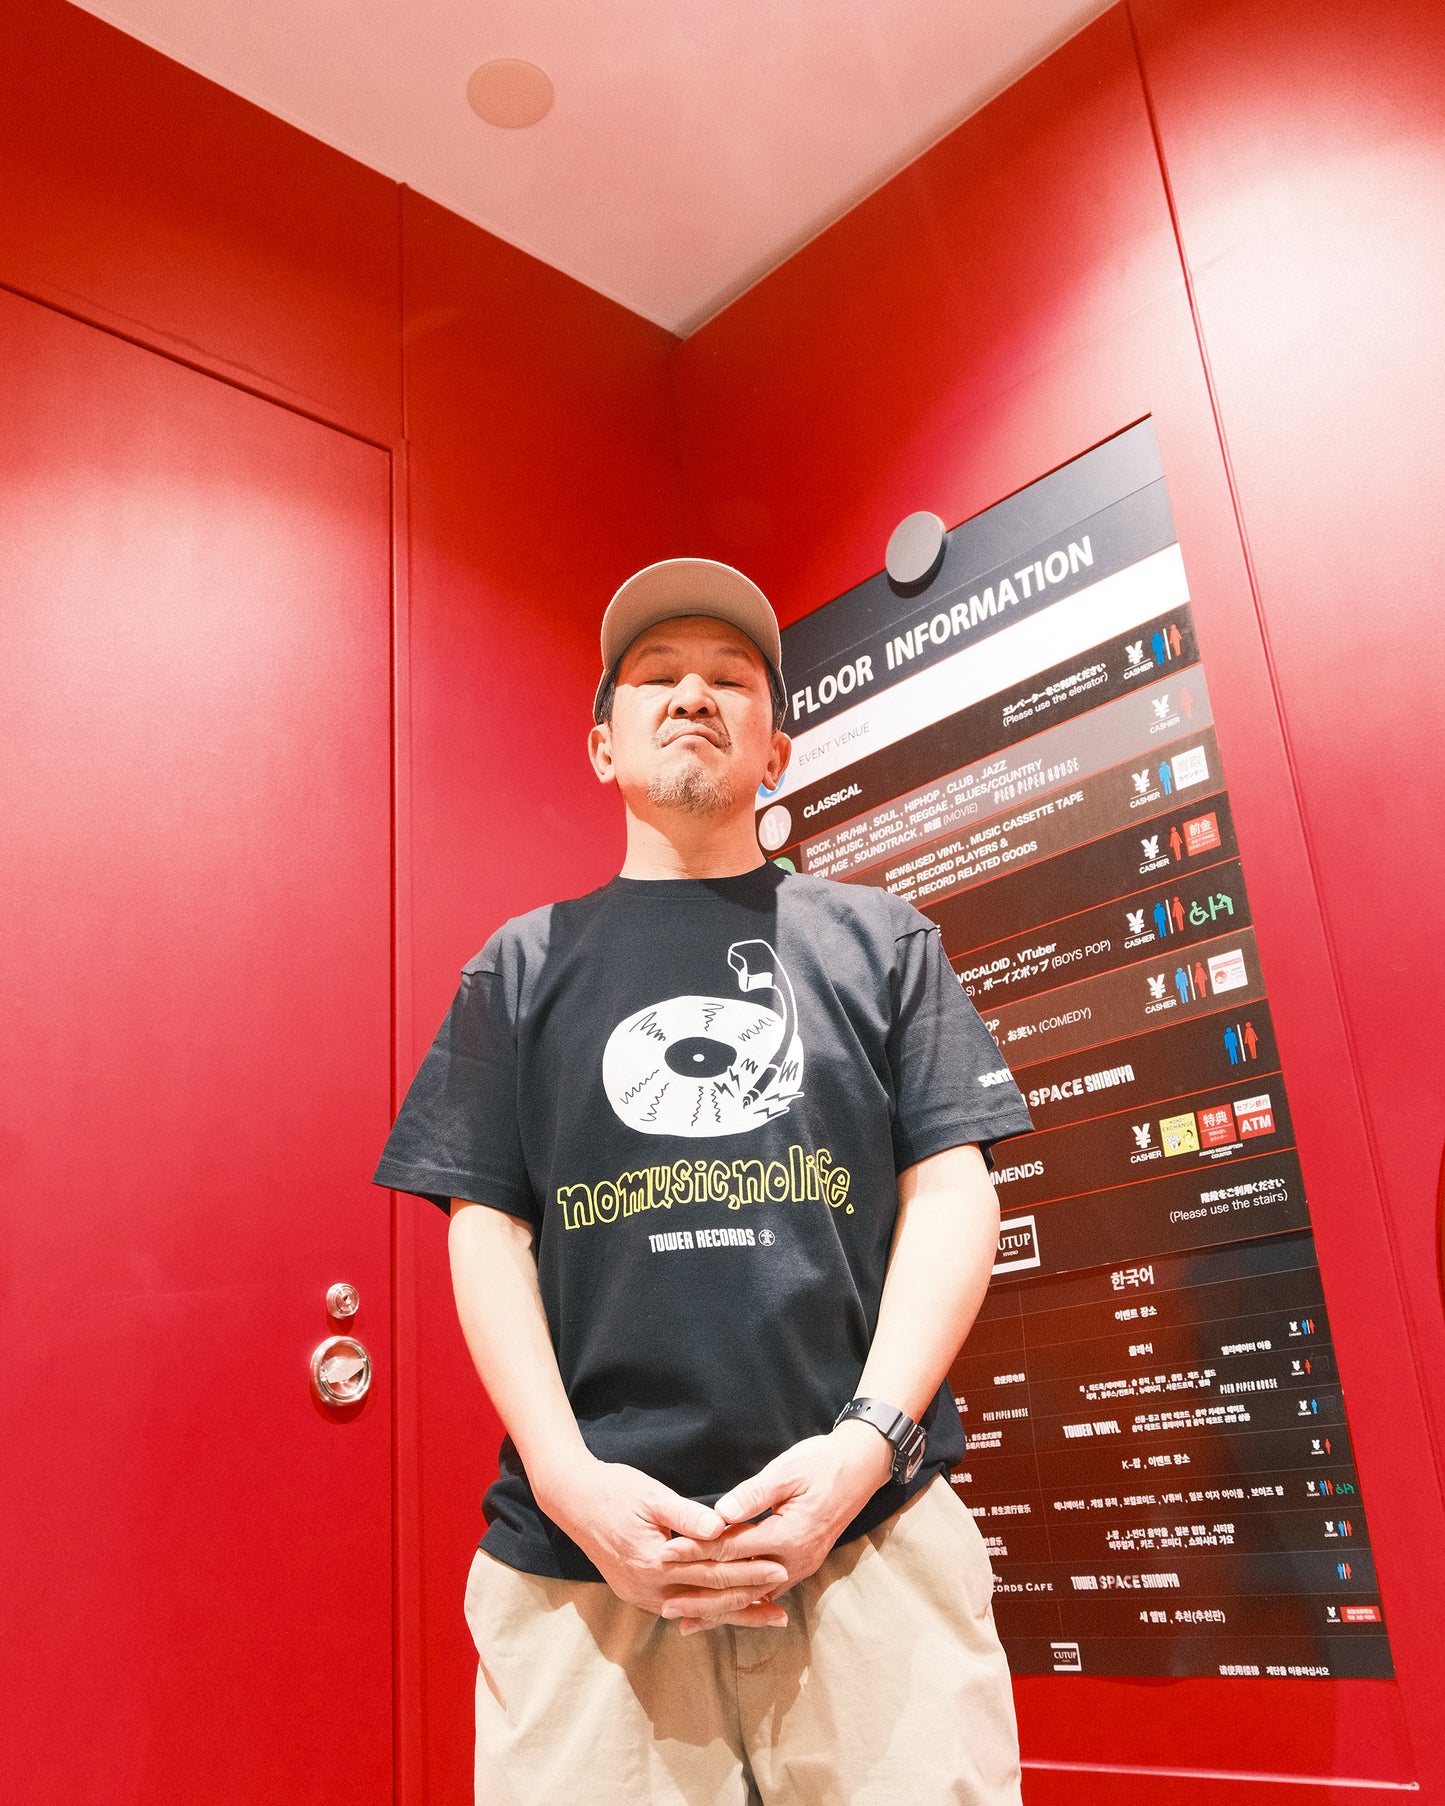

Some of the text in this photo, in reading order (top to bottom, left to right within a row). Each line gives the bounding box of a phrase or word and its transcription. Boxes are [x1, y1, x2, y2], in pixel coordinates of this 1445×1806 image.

[792, 535, 1094, 721] FLOOR INFORMATION
[1123, 662, 1154, 680] CASHIER
[1002, 671, 1109, 728] (Please use the elevator)
[1149, 716, 1180, 735] CASHIER
[798, 722, 870, 767] EVENT VENUE
[803, 783, 862, 818] CLASSICAL
[806, 759, 1007, 858] ROCK HR/HM SOUL HIPHOP CLUB JAZZ
[1130, 791, 1160, 808] CASHIER
[808, 851, 836, 871] ASIAN
[835, 838, 864, 859] MUSIC
[869, 821, 904, 842] WORLD
[909, 802, 948, 825] REGGAE
[955, 759, 1043, 807] BLUES/COUNTRY
[855, 830, 918, 864] SOUNDTRACK
[943, 802, 978, 826] (MOVIE)
[885, 853, 936, 881] NEW&USED
[970, 824, 1001, 846] MUSIC
[1002, 803, 1054, 832] CASSETTE
[1055, 791, 1084, 810] TAPE
[886, 838, 1008, 894] MUSIC RECORD PLAYERS &
[918, 841, 1038, 897] RECORD RELATED GOODS
[1139, 857, 1170, 874] CASHIER
[1124, 933, 1156, 950] CASHIER
[957, 943, 1057, 984] VOCALOID VTuber
[1052, 949, 1083, 970] (BOYS
[1085, 939, 1111, 959] POP)
[1145, 999, 1177, 1014] CASHIER
[1007, 1024, 1037, 1043] お笑い
[1039, 1007, 1092, 1034] (COMEDY)
[1029, 1077, 1084, 1107] SPACE
[1084, 1064, 1135, 1093] SHIBUYA
[1236, 1099, 1270, 1112] セブン銀行
[1162, 1121, 1195, 1133] EXCHANGE
[1203, 1110, 1228, 1127] 特典
[1241, 1115, 1271, 1133] ATM
[1130, 1150, 1162, 1164] CASHIER
[1200, 1178, 1285, 1204] 階段をご利用ください
[1169, 1189, 1288, 1223] (Please use the stairs)
[649, 1228, 755, 1253] TOWER RECORDS
[1110, 1265, 1155, 1291] 한국어
[1115, 1306, 1158, 1321] 이벤트 장소
[1220, 1341, 1256, 1356] 엘리베이터
[1063, 1420, 1121, 1438] TOWER VINYL
[1173, 1453, 1191, 1465] 장소
[1025, 1582, 1053, 1592] CAFE
[1070, 1572, 1180, 1590] TOWER SPACE SHIBUYA
[1140, 1611, 1148, 1623] 새
[1054, 1651, 1077, 1659] CUTUP
